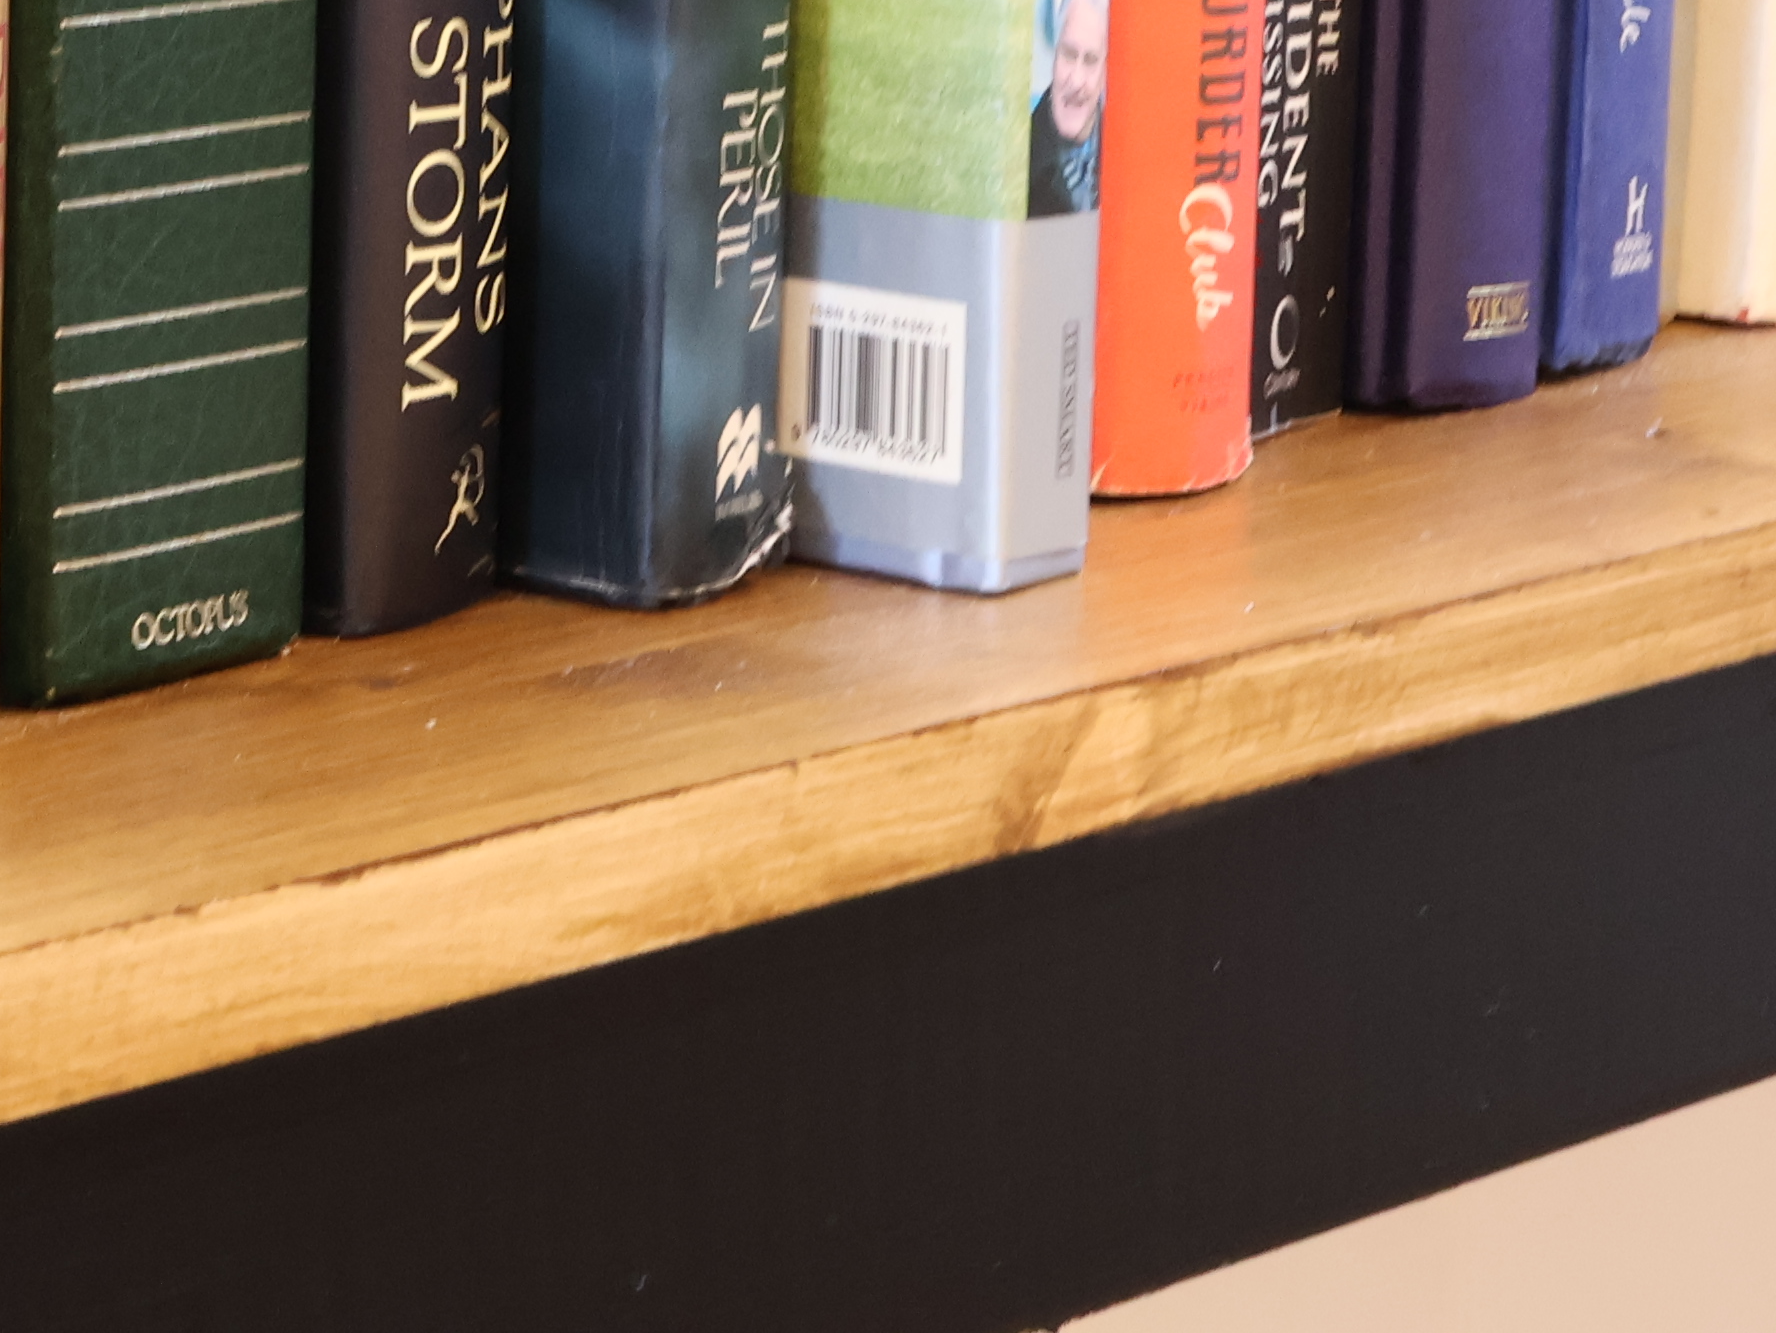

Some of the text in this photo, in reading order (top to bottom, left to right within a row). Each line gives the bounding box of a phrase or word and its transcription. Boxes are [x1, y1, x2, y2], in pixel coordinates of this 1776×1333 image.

[400, 15, 473, 413] STORM
[714, 86, 761, 290] PERIL
[1179, 182, 1236, 333] Club
[132, 588, 250, 651] OCTOPUS
